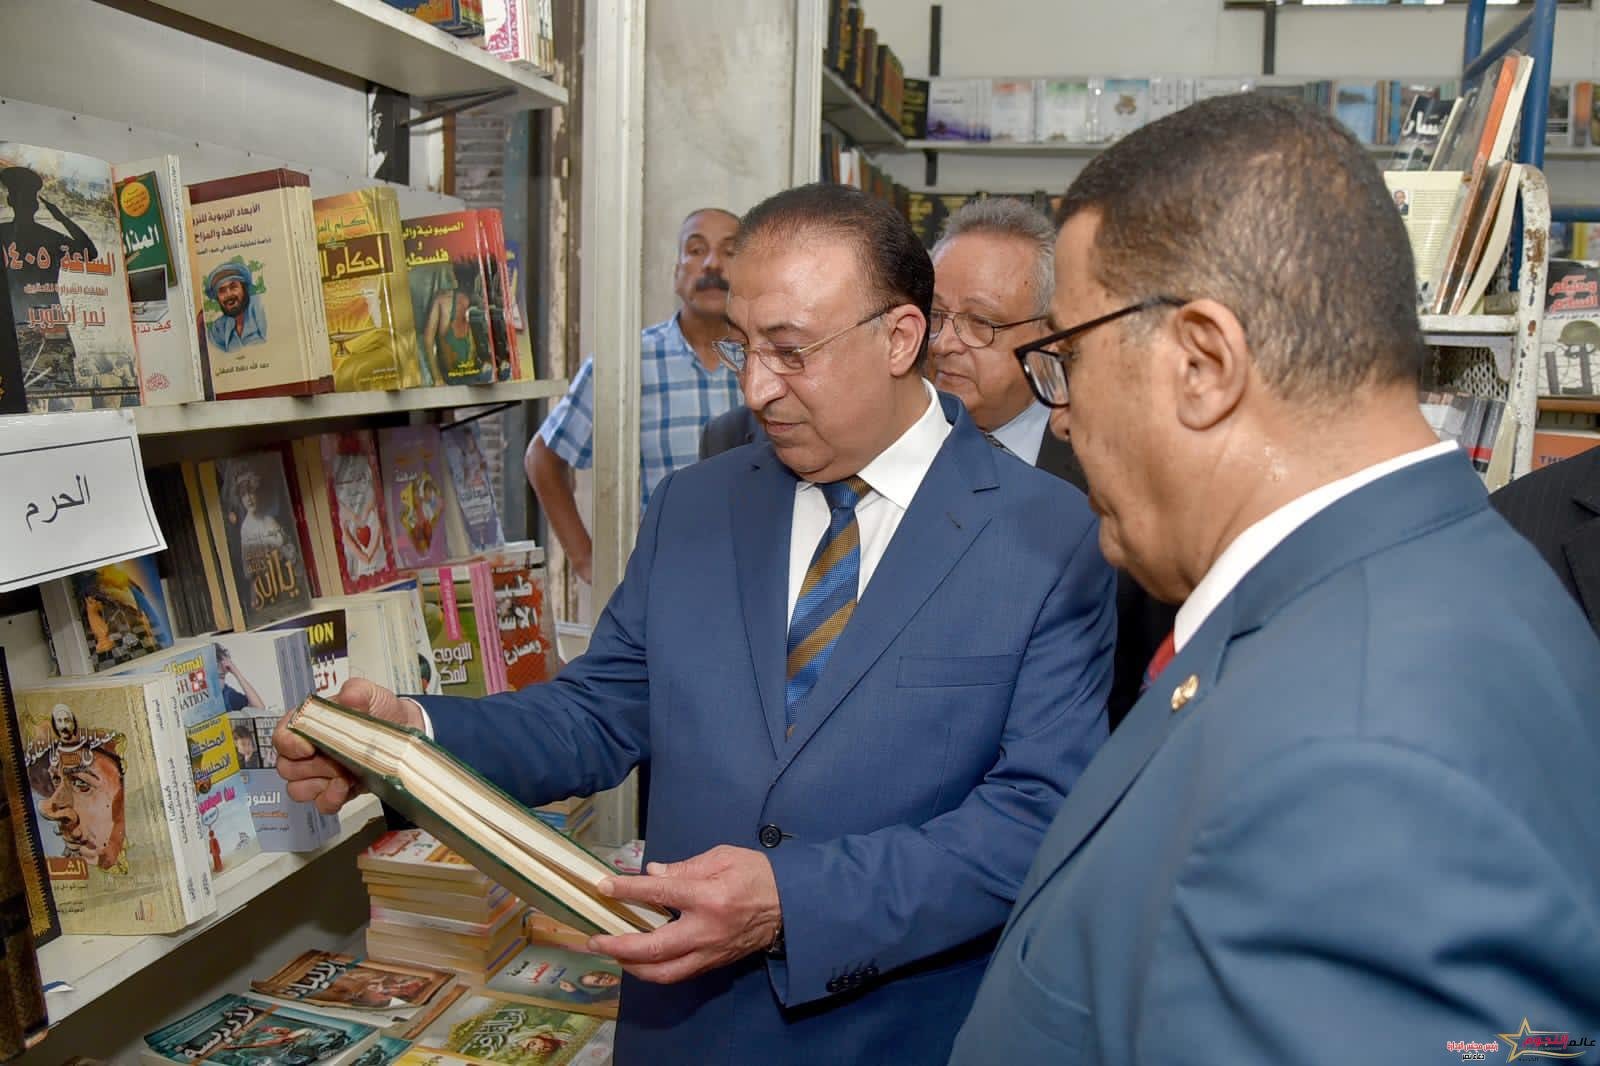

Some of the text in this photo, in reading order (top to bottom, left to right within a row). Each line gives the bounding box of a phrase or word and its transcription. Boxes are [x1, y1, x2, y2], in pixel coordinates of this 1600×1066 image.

[122, 223, 161, 254] المذا
[25, 472, 91, 533] الحرم
[305, 621, 335, 646] ION
